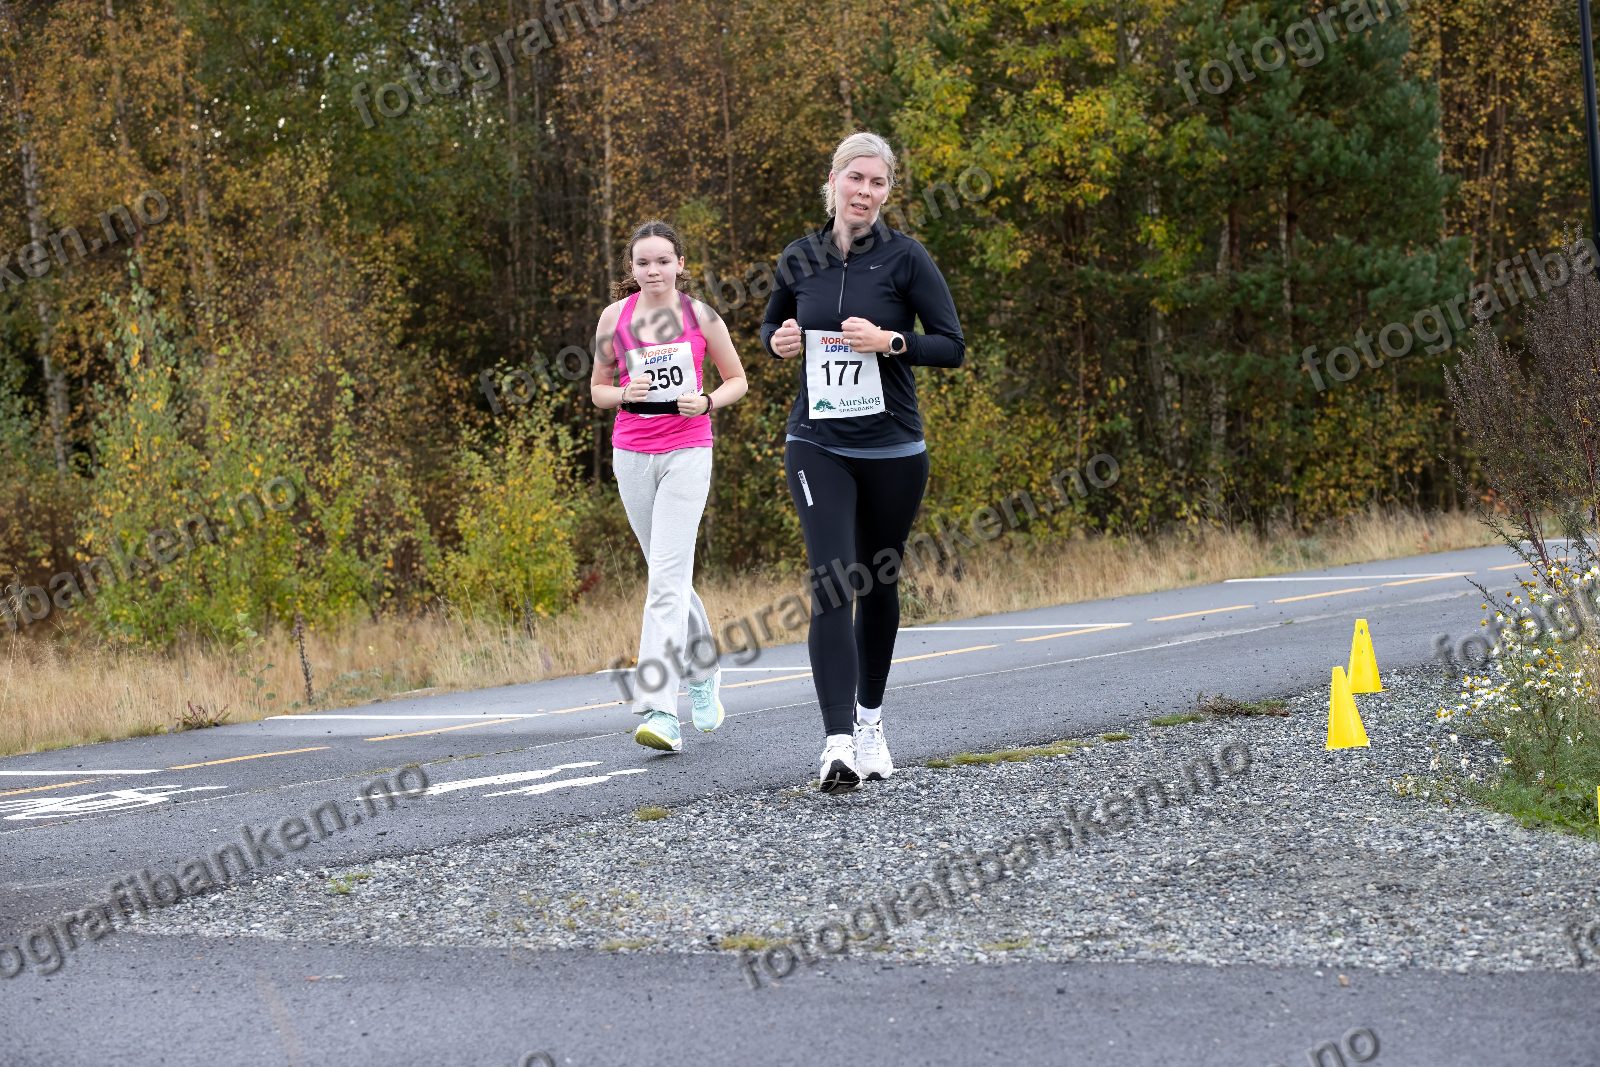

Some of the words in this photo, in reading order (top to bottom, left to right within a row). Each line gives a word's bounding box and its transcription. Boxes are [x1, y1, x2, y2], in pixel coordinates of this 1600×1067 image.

[644, 353, 674, 365] LØPET
[643, 365, 683, 391] 250
[821, 360, 862, 386] 177
[838, 396, 881, 406] Aurskog
